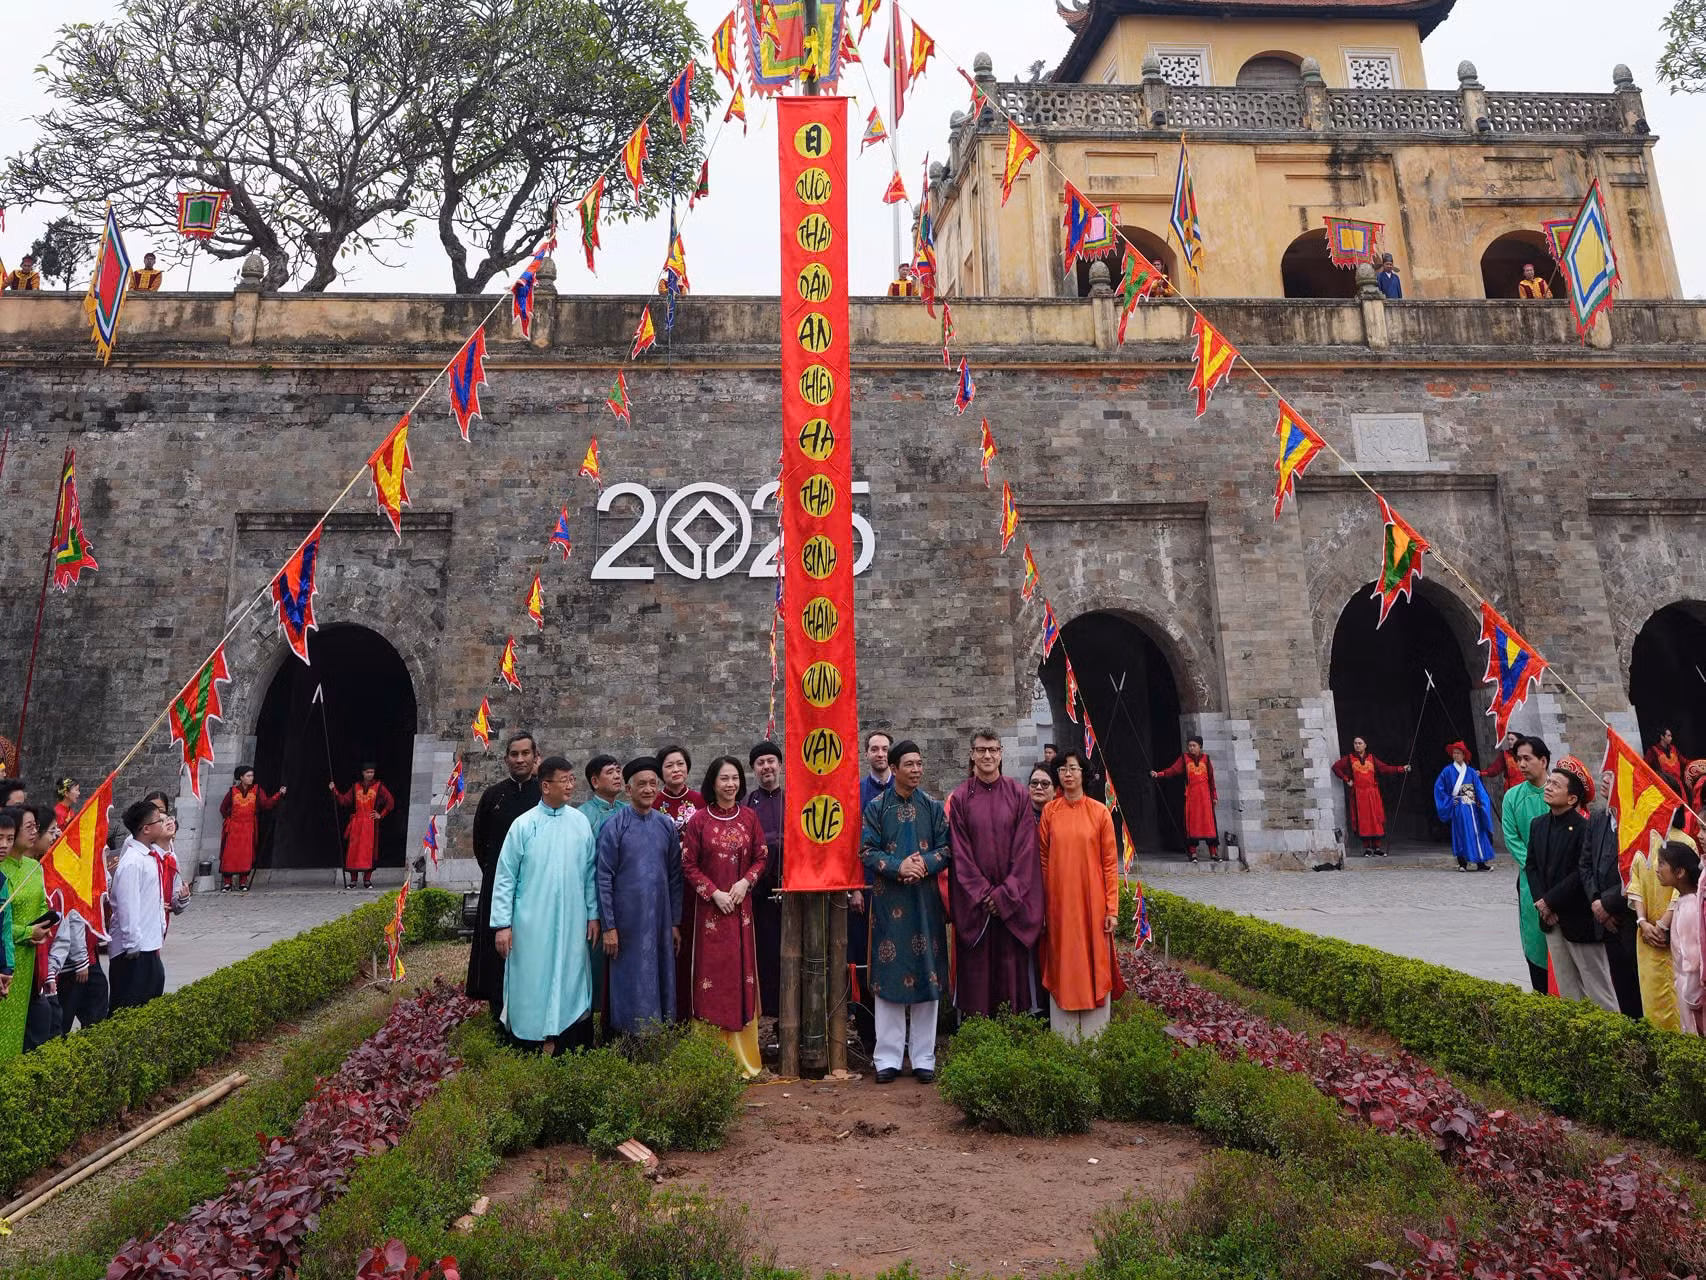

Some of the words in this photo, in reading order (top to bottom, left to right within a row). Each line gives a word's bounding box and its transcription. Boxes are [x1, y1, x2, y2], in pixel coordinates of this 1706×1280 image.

[796, 169, 831, 202] QUỐC
[799, 216, 831, 251] THÁI
[800, 265, 830, 300] DÂN
[800, 367, 833, 404] THIÊN
[800, 421, 834, 458] HẠ
[802, 478, 834, 515] THÁI
[803, 537, 837, 576] BÌNH
[803, 600, 838, 640] THÁNH
[803, 729, 842, 774] VẠN
[802, 798, 840, 841] TUẾ
